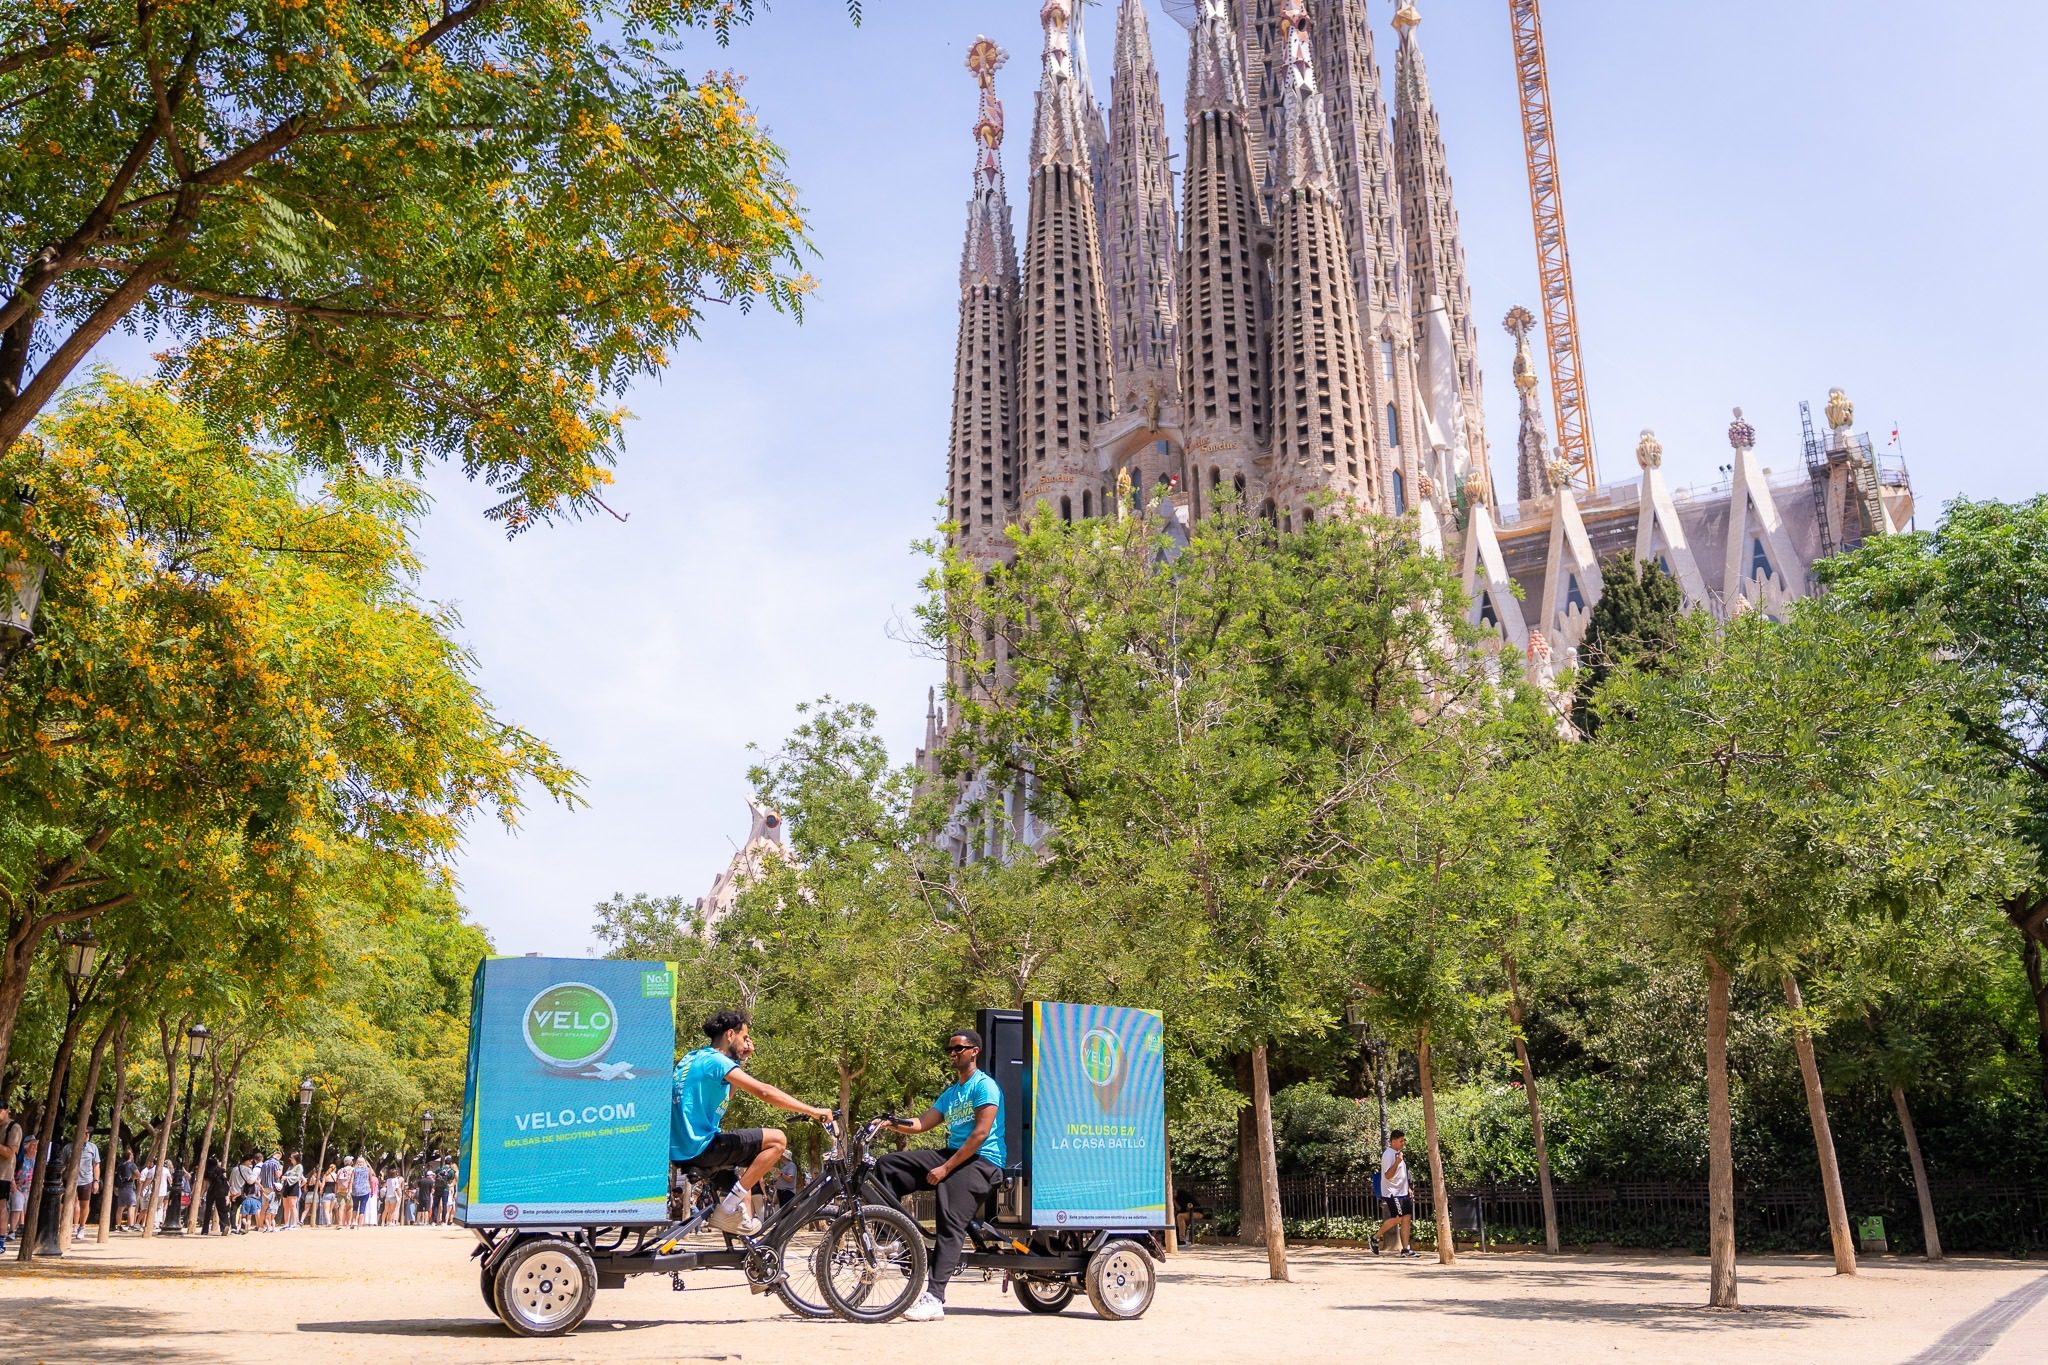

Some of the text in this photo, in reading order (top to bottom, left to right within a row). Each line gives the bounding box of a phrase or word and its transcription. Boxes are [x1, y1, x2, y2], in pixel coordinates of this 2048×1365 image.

[646, 972, 669, 983] No.1
[533, 1010, 610, 1030] VELO
[1084, 1047, 1112, 1068] VELO
[515, 1102, 635, 1131] VELO.COM
[504, 1136, 541, 1148] BOLSAS
[543, 1135, 553, 1144] DE
[556, 1130, 597, 1142] NICOTINA
[599, 1128, 613, 1136] SIN
[1067, 1123, 1136, 1136] INCLUSO EN
[1052, 1136, 1146, 1150] LA CASA BATLLÓ
